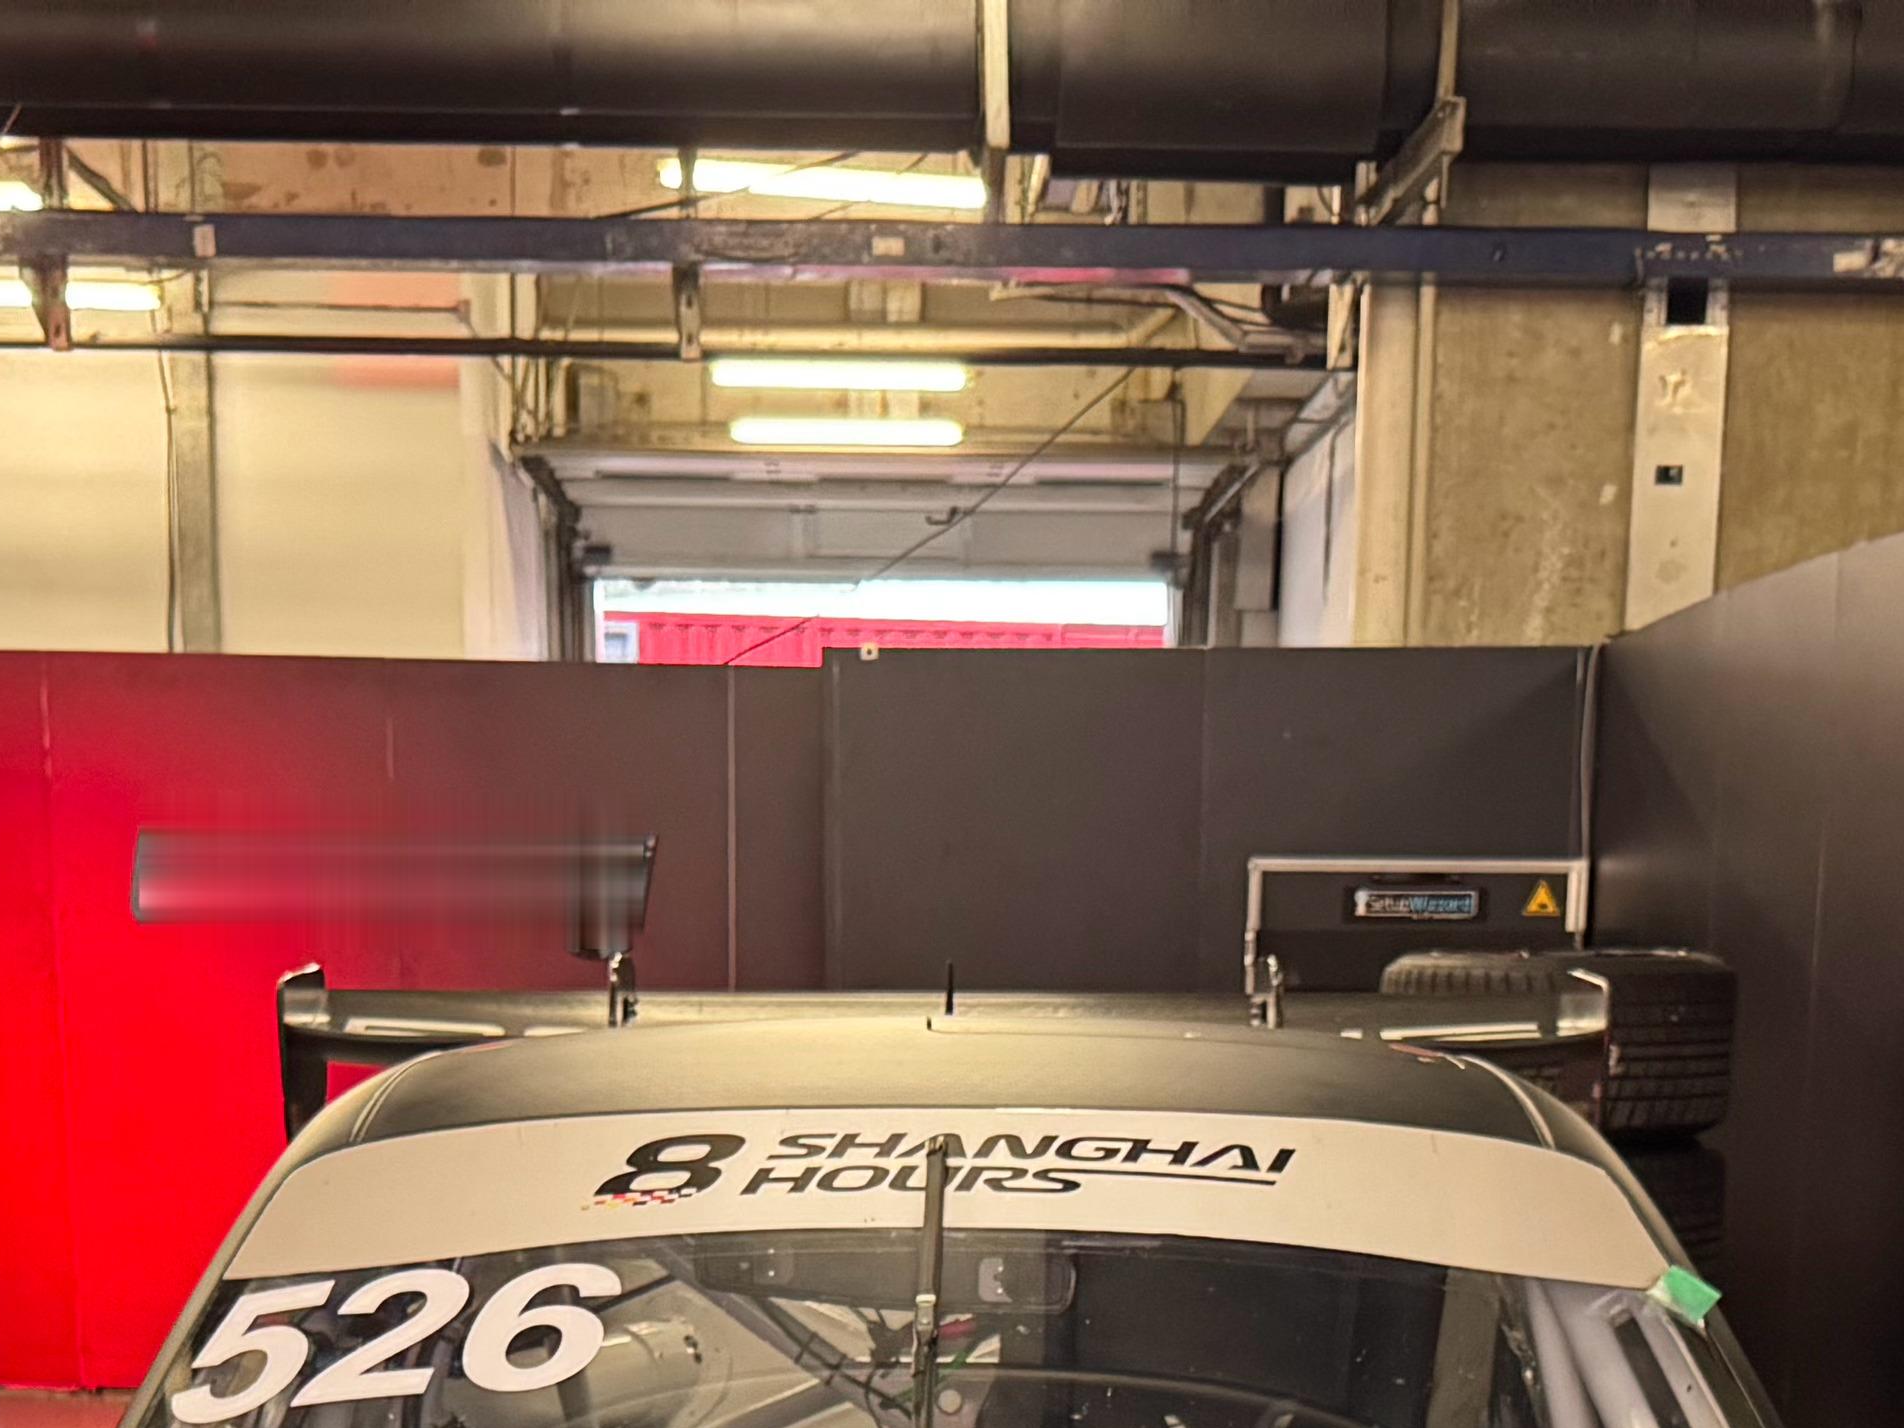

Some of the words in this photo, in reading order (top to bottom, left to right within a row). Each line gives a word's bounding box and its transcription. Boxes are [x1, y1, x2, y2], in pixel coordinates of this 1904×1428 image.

[593, 1133, 746, 1197] 8
[766, 1131, 1297, 1174] SHANGHAI
[739, 1165, 1081, 1195] HOURS
[170, 1262, 623, 1425] 526
